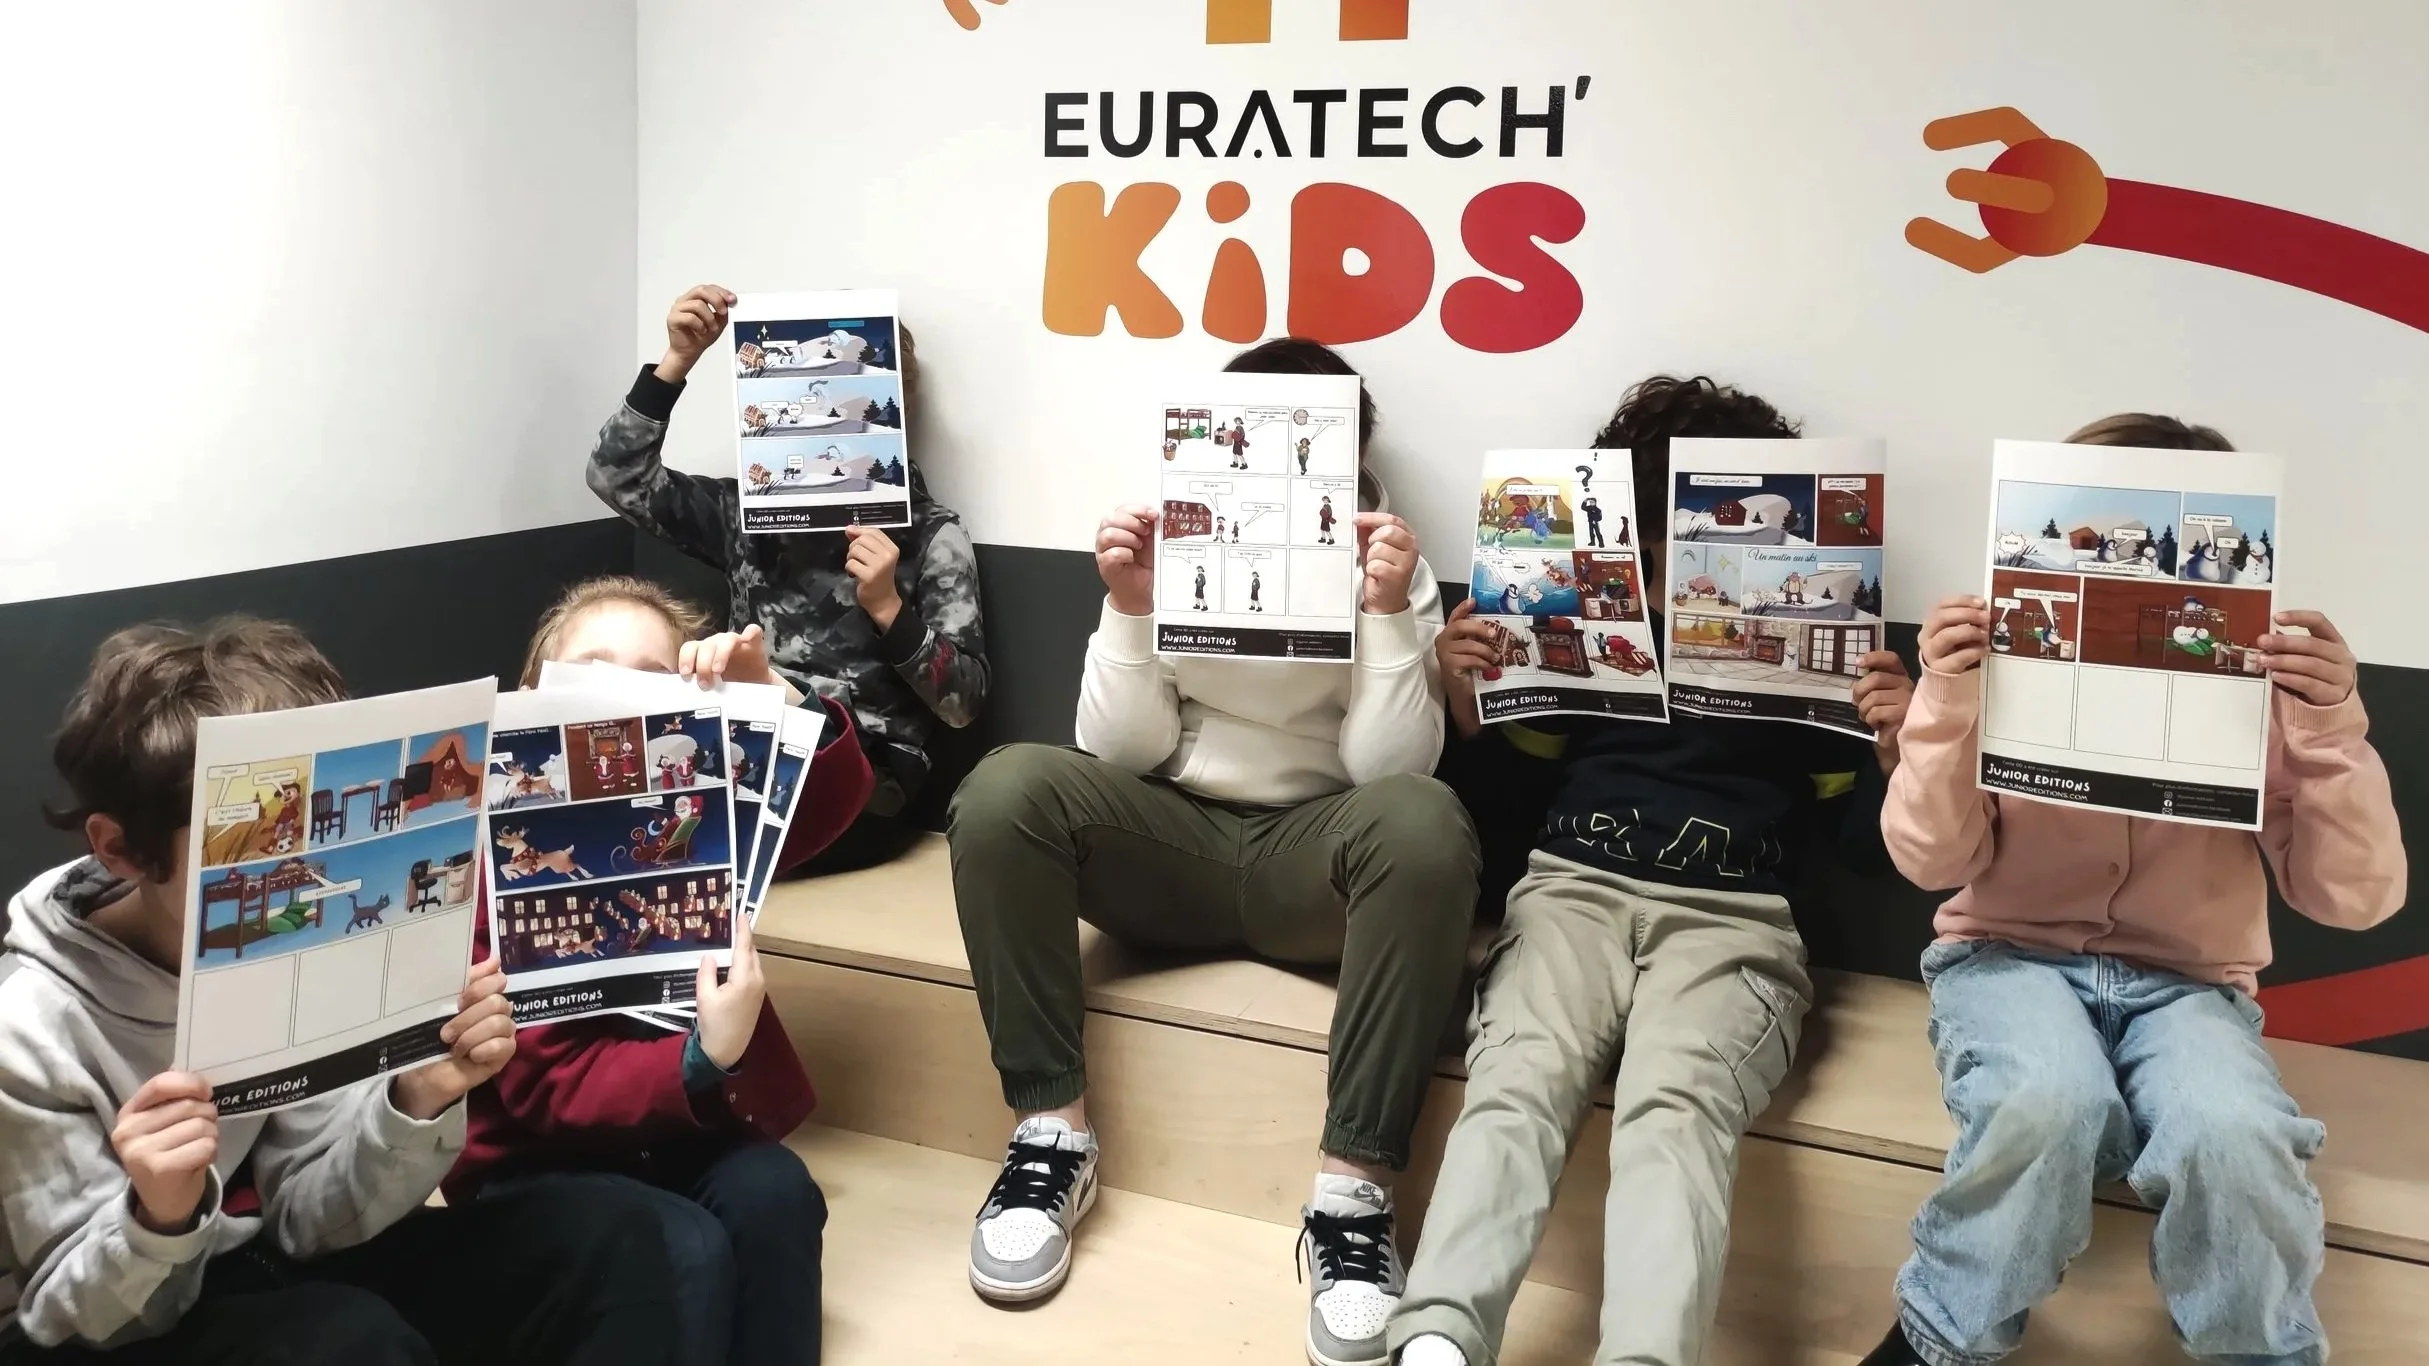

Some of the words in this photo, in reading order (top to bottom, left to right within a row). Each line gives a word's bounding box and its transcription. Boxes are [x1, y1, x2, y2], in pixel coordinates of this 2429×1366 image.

[776, 513, 811, 522] EDITIONS
[1748, 548, 1767, 561] Un
[1768, 552, 1791, 562] matin
[1805, 553, 1818, 563] ski
[1162, 631, 1194, 644] JUNIOR
[1197, 635, 1237, 646] EDITIONS
[1485, 698, 1518, 710] JUNIOR
[1520, 695, 1558, 705] EDITIONS
[1673, 689, 1707, 704] JUNIOR
[1709, 697, 1753, 708] EDITIONS
[1986, 763, 2030, 783] JUNIOR
[2034, 774, 2090, 792] EDITIONS
[1985, 778, 2088, 801] WWW.JUNIOREDITIONS.COM
[552, 989, 603, 1007] EDITIONS
[246, 1075, 309, 1101] EDITIONS
